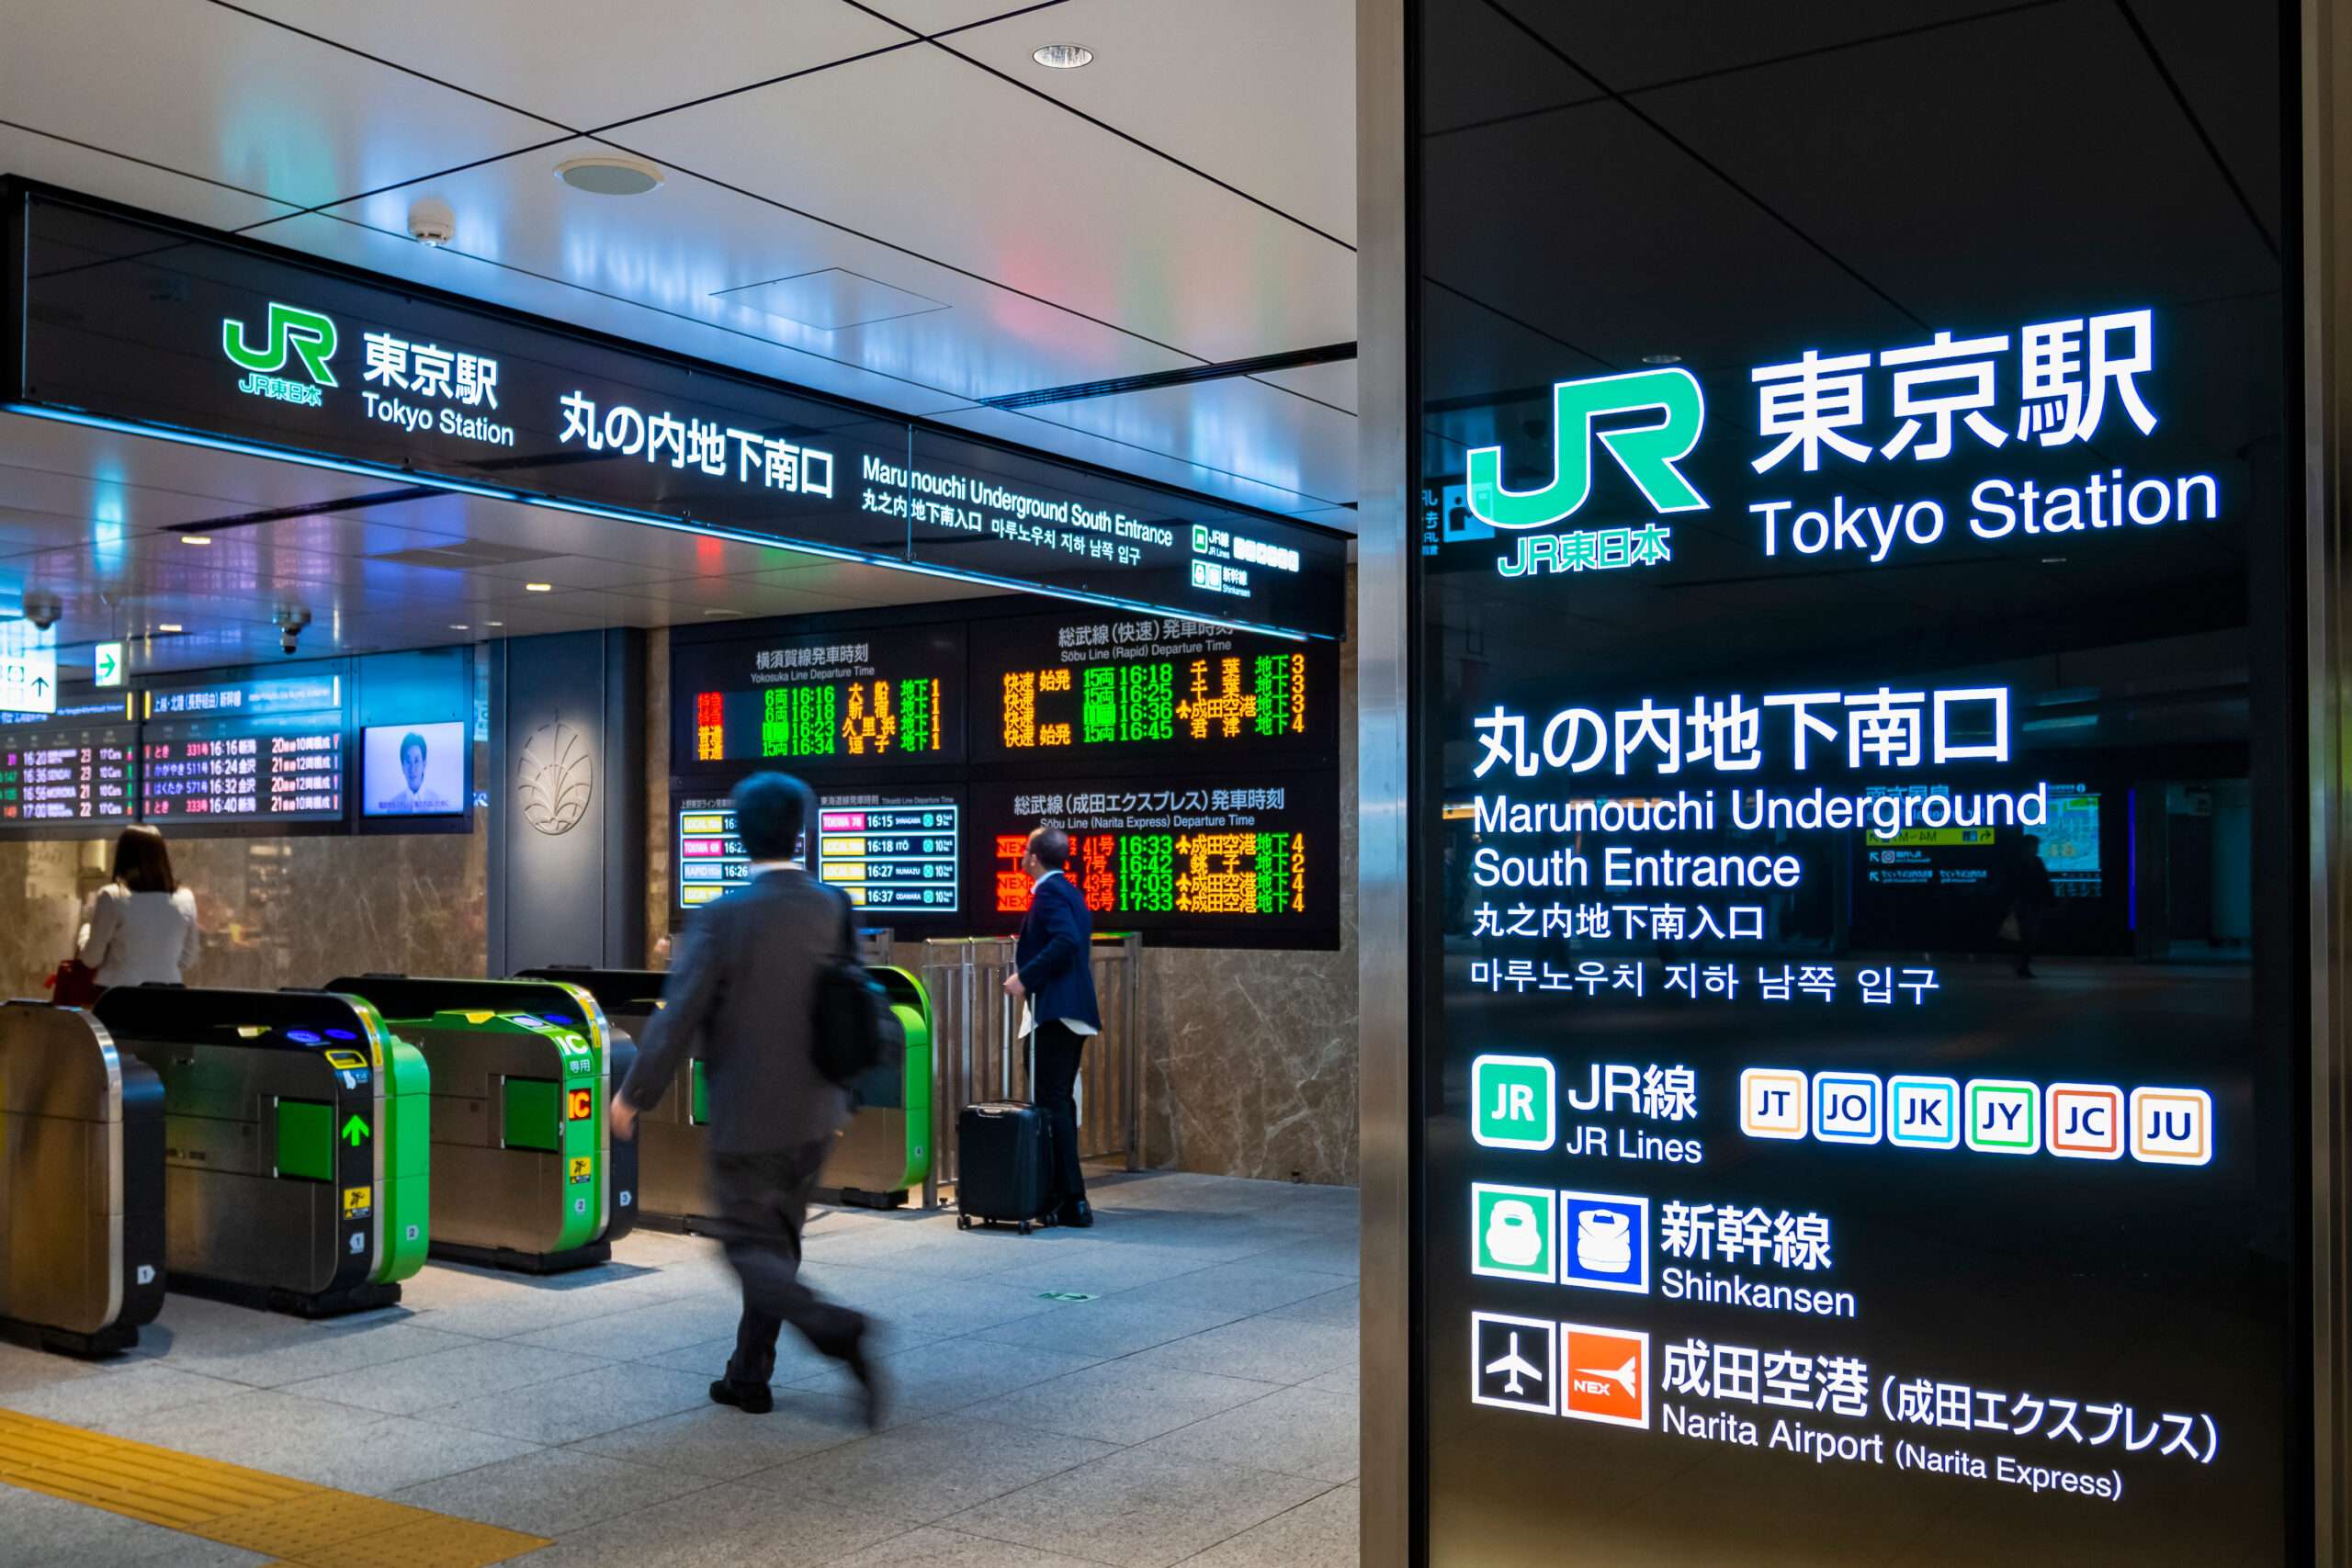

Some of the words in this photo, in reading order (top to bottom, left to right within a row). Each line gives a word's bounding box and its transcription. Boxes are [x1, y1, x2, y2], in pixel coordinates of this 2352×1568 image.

[223, 301, 338, 388] JR
[363, 333, 498, 410] 東京駅
[239, 373, 322, 407] JR東日本
[1750, 310, 2158, 476] 東京駅
[362, 392, 433, 432] Tokyo
[439, 409, 514, 446] Station
[559, 390, 833, 499] 丸の内地下南口
[1466, 367, 1709, 529] JR
[864, 455, 966, 501] Marunouchi
[970, 479, 1068, 523] Underground
[1071, 503, 1113, 533] South
[1115, 515, 1172, 546] Entrance
[1748, 496, 1945, 563] Tokyo
[1970, 468, 2216, 538] Station
[991, 517, 1056, 549] 마루노우치
[1061, 533, 1085, 555] 지하
[1090, 539, 1114, 560] 남쪽
[1117, 546, 1141, 566] 입구
[1497, 525, 1671, 578] JR東日本
[756, 643, 868, 670] 横須賀線発車時刻
[1089, 649, 1109, 660] Line
[1113, 647, 1148, 660] (Rapid)
[1151, 643, 1203, 657] Departure
[1205, 639, 1232, 651] Time
[751, 672, 789, 683] Yokosuka
[791, 671, 808, 681] Line
[810, 668, 852, 681] Departure
[854, 666, 875, 676] Time
[1004, 672, 1035, 693] 快速
[1040, 669, 1070, 692] 始発
[1120, 664, 1172, 685] 16:18
[1255, 656, 1289, 676] 地下
[1292, 654, 1305, 674] 3
[792, 685, 835, 705] 16:16
[932, 678, 940, 696] 1
[1004, 692, 1035, 711] 快速
[1120, 683, 1172, 704] 16:25
[1255, 676, 1289, 696] 地下
[1292, 674, 1305, 694] 3
[792, 704, 835, 722] 16:18
[932, 697, 940, 714] 1
[1004, 709, 1035, 728] 快速
[1120, 702, 1172, 723] 16:36
[1255, 695, 1289, 716] 地下
[1292, 694, 1305, 713] 3
[792, 720, 835, 739] 16:23
[932, 716, 940, 732] 1
[1004, 727, 1035, 748] 快速
[1040, 724, 1070, 746] 始発
[1120, 721, 1172, 741] 16:45
[1255, 714, 1289, 735] 地下
[1292, 713, 1305, 733] 4
[1473, 687, 2008, 778] 丸の内地下南口
[210, 739, 237, 756] 16:16
[792, 738, 835, 755] 16:34
[932, 732, 940, 750] 1
[210, 760, 237, 775] 16:24
[210, 779, 237, 795] 16:32
[80, 802, 91, 817] 22
[210, 797, 237, 813] 16:40
[1474, 790, 1714, 834] Marunouchi
[1732, 782, 2047, 839] Underground
[867, 815, 893, 828] 16:15
[936, 815, 943, 827] 9
[1068, 818, 1088, 829] Line
[1091, 817, 1124, 829] (Narita
[1126, 815, 1170, 829] Express)
[1173, 815, 1226, 829] Departure
[1228, 814, 1255, 826] Time
[867, 840, 893, 852] 16:18
[935, 840, 943, 852] 10
[1083, 835, 1114, 856] 41号
[1120, 835, 1172, 855] 16:33
[1191, 833, 1257, 855] 成田空港
[1255, 833, 1289, 854] 地下
[1292, 833, 1305, 853] 4
[725, 866, 748, 877] 16:26
[867, 865, 893, 877] 16:27
[935, 865, 943, 876] 10
[1120, 854, 1172, 874] 16:42
[1255, 854, 1289, 874] 地下
[1292, 854, 1305, 873] 2
[1474, 848, 1588, 886] South
[1605, 847, 1800, 887] Entrance
[867, 890, 893, 903] 16:37
[935, 891, 943, 902] 10
[1083, 873, 1114, 893] 43号
[1120, 874, 1172, 893] 17:03
[1191, 872, 1257, 894] 成田空港
[1255, 873, 1289, 893] 地下
[1292, 874, 1305, 892] 4
[1120, 892, 1172, 911] 17:33
[1191, 892, 1257, 912] 成田空港
[1255, 893, 1289, 913] 地下
[1292, 893, 1305, 912] 4
[1472, 901, 1762, 941] 丸之内地下南入口
[1471, 958, 1644, 998] 마루노우치
[1664, 963, 1739, 999] 지하
[1758, 964, 1837, 1002] 남쪽
[1858, 966, 1939, 1005] 입구
[556, 1034, 589, 1055] IC
[570, 1059, 591, 1074] 専用
[568, 1091, 590, 1119] IC
[1492, 1083, 1534, 1122] JR
[1568, 1064, 1698, 1121] JR線
[1758, 1090, 1790, 1117] JT
[1826, 1094, 1868, 1122] JO
[1904, 1098, 1943, 1126] JK
[1983, 1102, 2022, 1131] JY
[2064, 1107, 2106, 1136] JC
[2146, 1111, 2191, 1141] JU
[1566, 1125, 1608, 1156] JR
[1619, 1129, 1702, 1164] Lines
[1660, 1200, 1832, 1272] 新幹線
[1661, 1268, 1855, 1318] Shinkansen
[1661, 1338, 1869, 1417] 成田空港
[1663, 1404, 1759, 1447] Narita
[1769, 1420, 1883, 1465] Airport
[1895, 1439, 1987, 1480] (Narita
[1996, 1456, 2122, 1502] Express)
